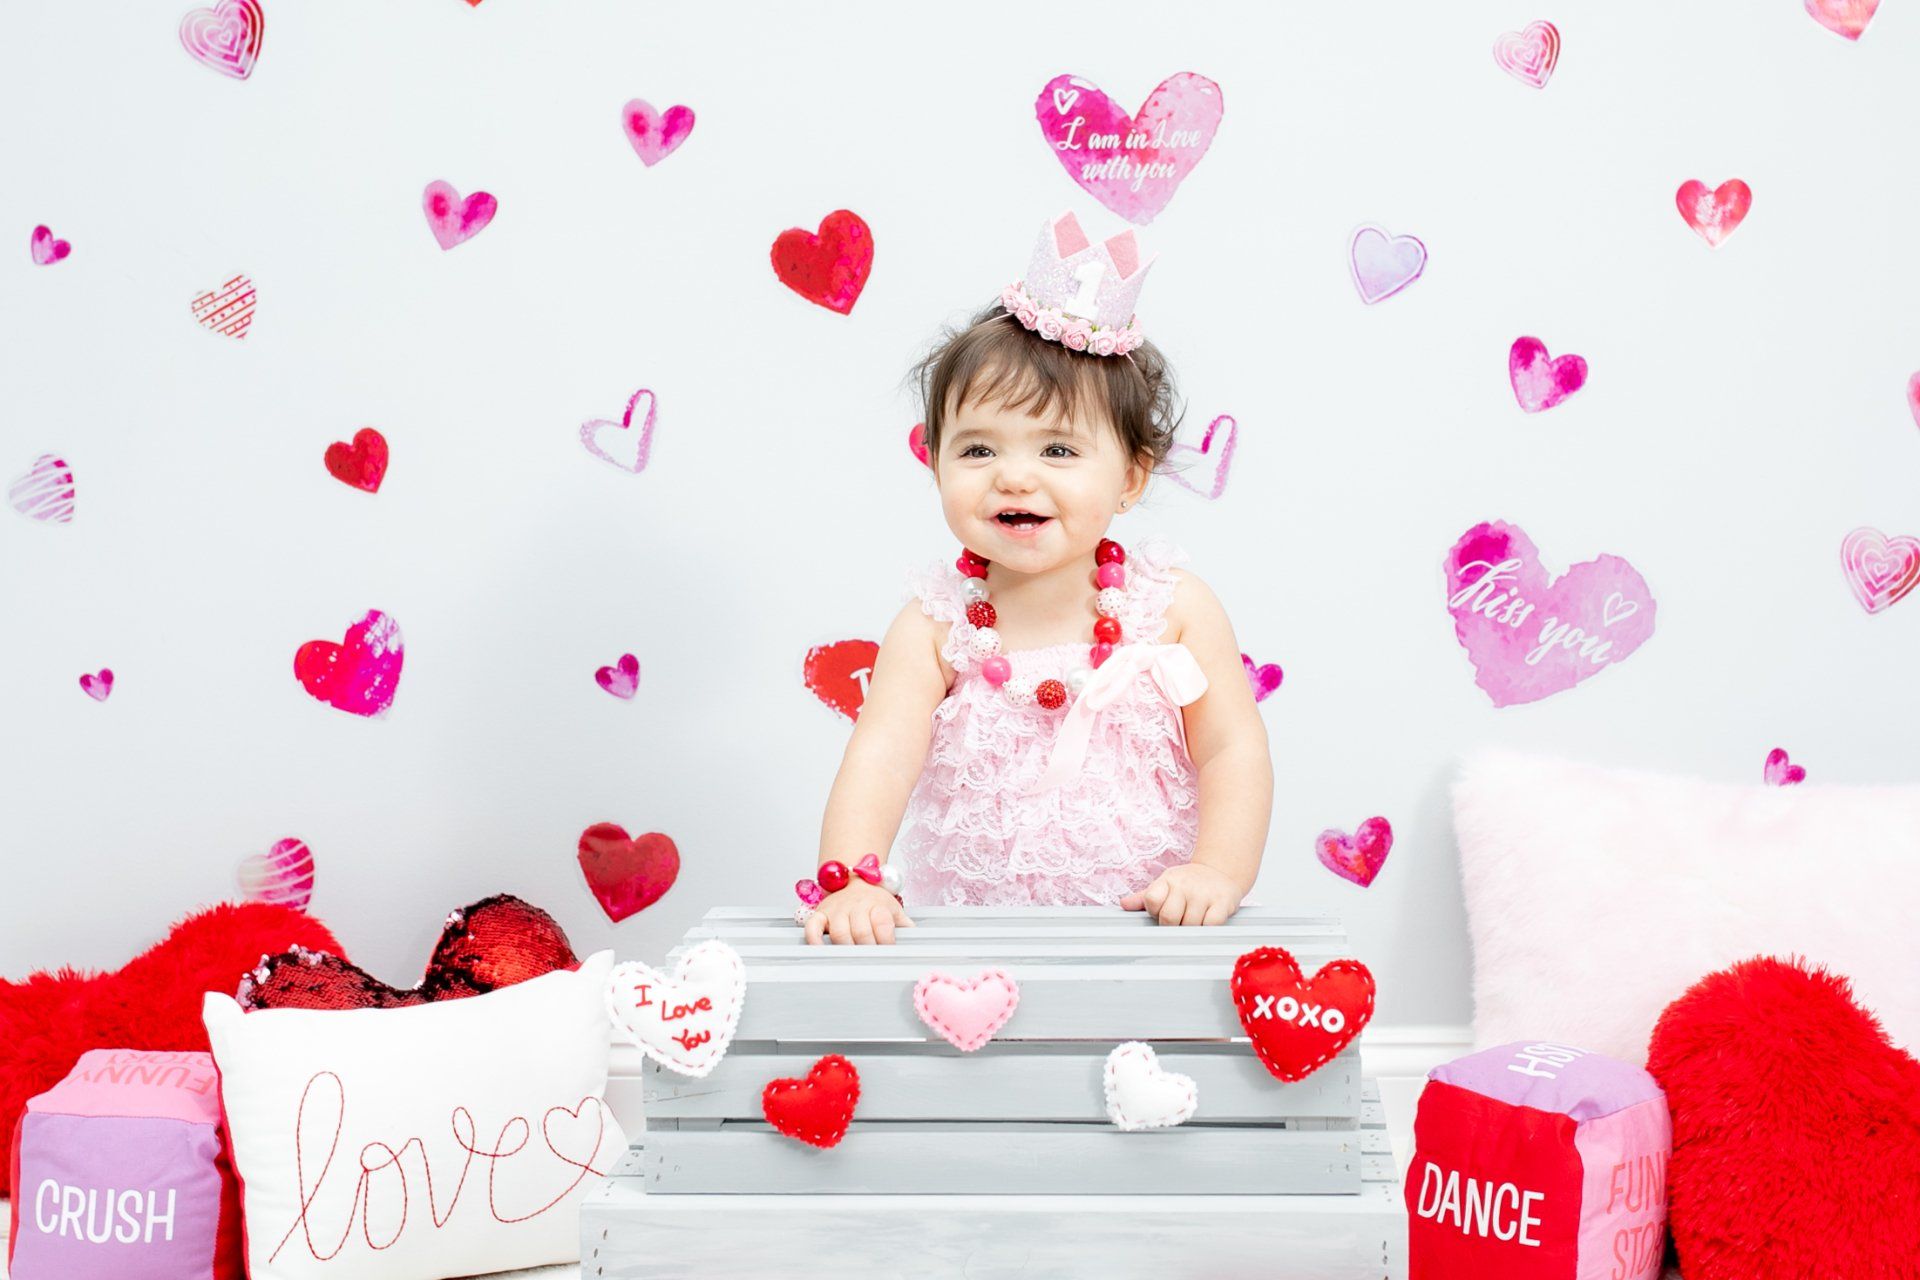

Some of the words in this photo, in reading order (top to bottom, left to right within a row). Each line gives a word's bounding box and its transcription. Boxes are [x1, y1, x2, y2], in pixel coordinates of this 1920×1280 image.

[1088, 130, 1122, 150] am
[1125, 128, 1150, 150] in
[1148, 118, 1202, 150] Love
[1081, 154, 1131, 180] with
[1130, 160, 1177, 192] you
[1065, 260, 1107, 321] 1
[1449, 558, 1535, 628] Kiss
[1524, 616, 1613, 666] you
[634, 984, 653, 1008] I
[661, 997, 713, 1021] Love
[1252, 994, 1345, 1034] XOXO
[671, 1028, 712, 1051] You
[268, 1070, 535, 1262] love
[35, 1178, 177, 1244] CRUSH
[1417, 1161, 1545, 1247] DANCE
